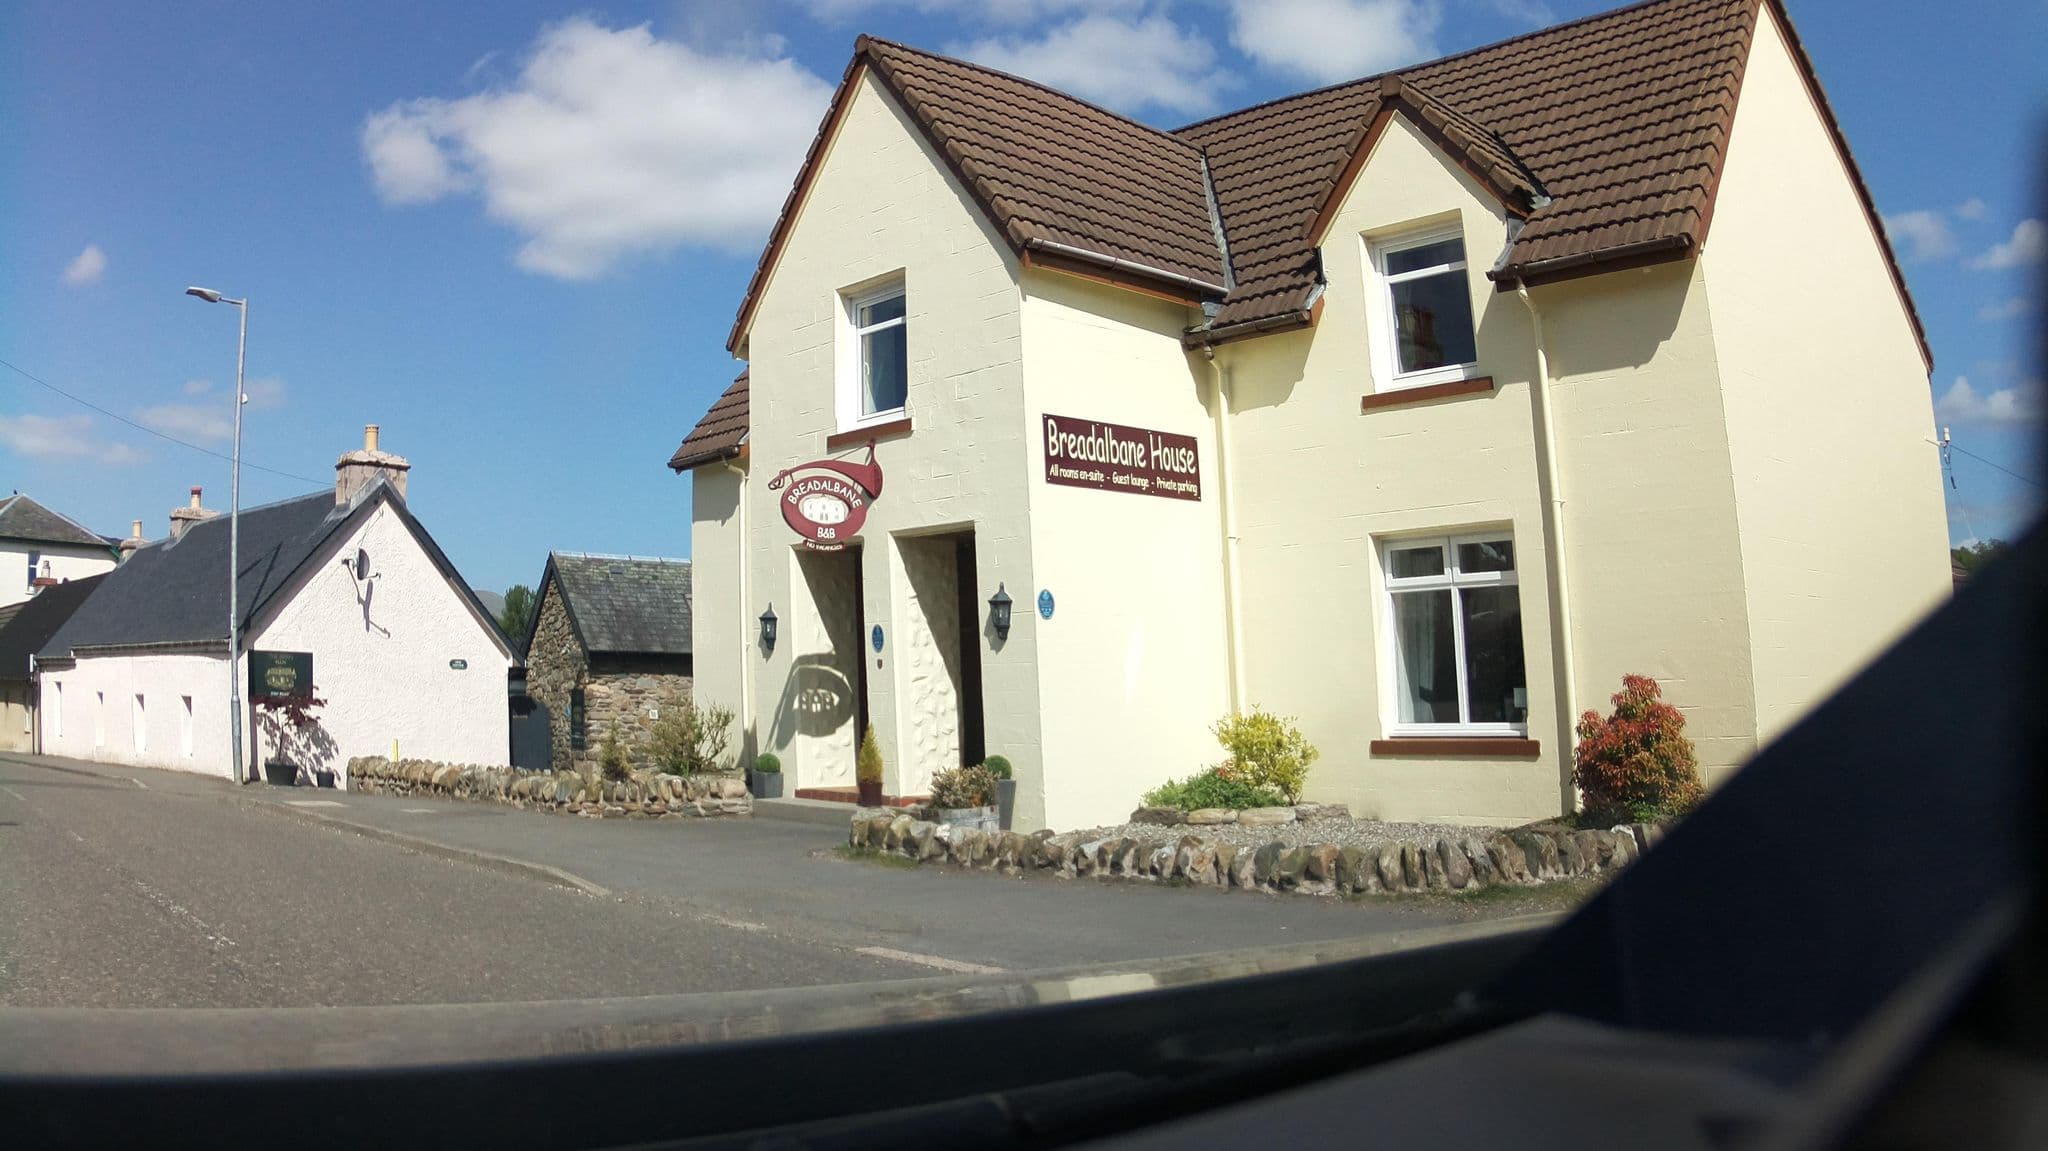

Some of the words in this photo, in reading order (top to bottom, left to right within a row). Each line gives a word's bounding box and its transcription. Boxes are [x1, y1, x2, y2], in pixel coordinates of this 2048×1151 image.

[1047, 418, 1146, 468] Breadalbane
[1149, 434, 1196, 474] House
[787, 480, 863, 508] BREADALBANE
[1050, 464, 1059, 476] All
[1060, 466, 1078, 479] rooms
[1079, 468, 1104, 482] en-suite
[1112, 471, 1130, 485] Guest
[1130, 475, 1149, 490] lounge
[1156, 476, 1176, 490] Private
[1177, 479, 1198, 496] parking
[817, 526, 836, 539] B&B
